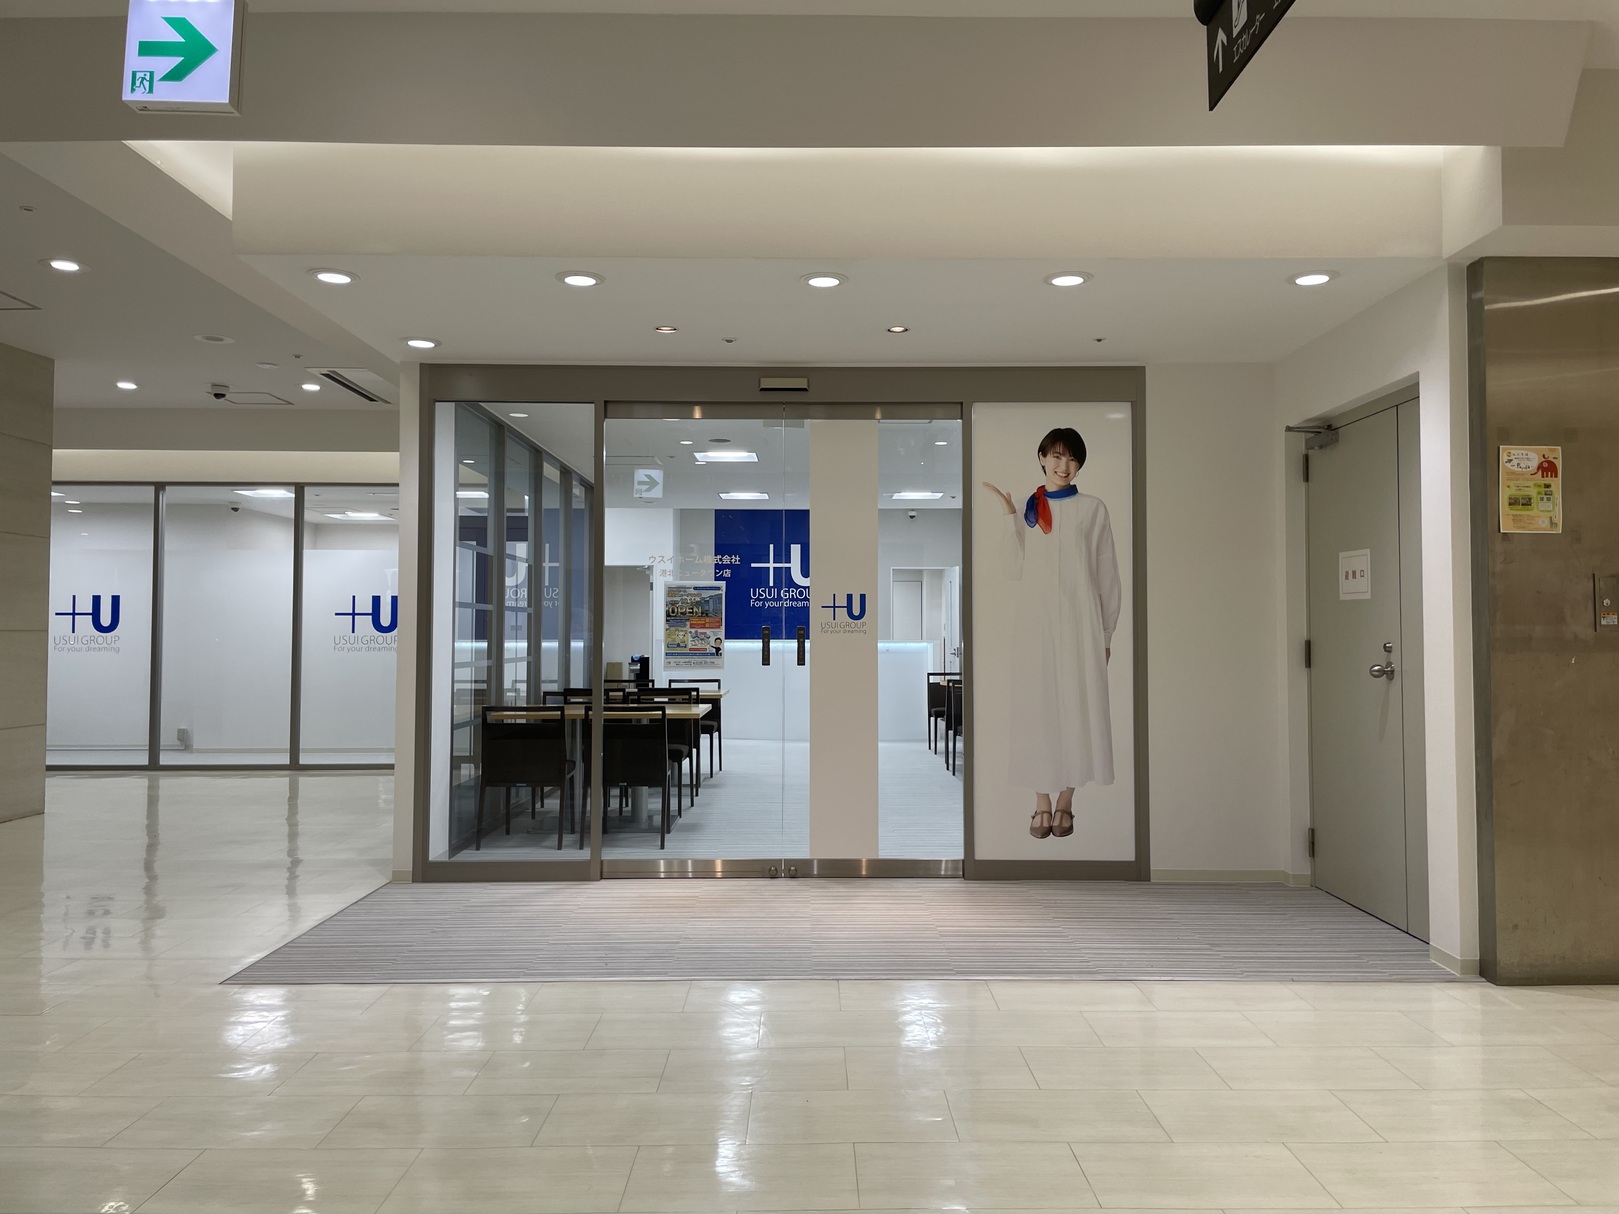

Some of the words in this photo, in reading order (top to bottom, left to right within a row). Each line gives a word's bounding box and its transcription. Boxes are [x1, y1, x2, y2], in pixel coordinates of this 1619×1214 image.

[1233, 12, 1265, 63] エスカレーター
[648, 554, 741, 565] ウスイホーム株式会社
[659, 568, 732, 578] 港北ニュータウン店
[750, 588, 777, 599] USUI
[780, 588, 810, 599] GROU
[750, 599, 763, 607] For
[764, 600, 783, 609] your
[783, 599, 809, 607] dream
[669, 605, 702, 617] OPEN
[839, 621, 867, 629] GROUP
[54, 635, 79, 646] USUI
[81, 635, 120, 646] GROUP
[333, 635, 359, 646] USUI
[54, 645, 66, 653] For
[67, 646, 83, 654] your
[85, 645, 120, 654] dreaming
[333, 645, 345, 653] For
[346, 646, 363, 654] your
